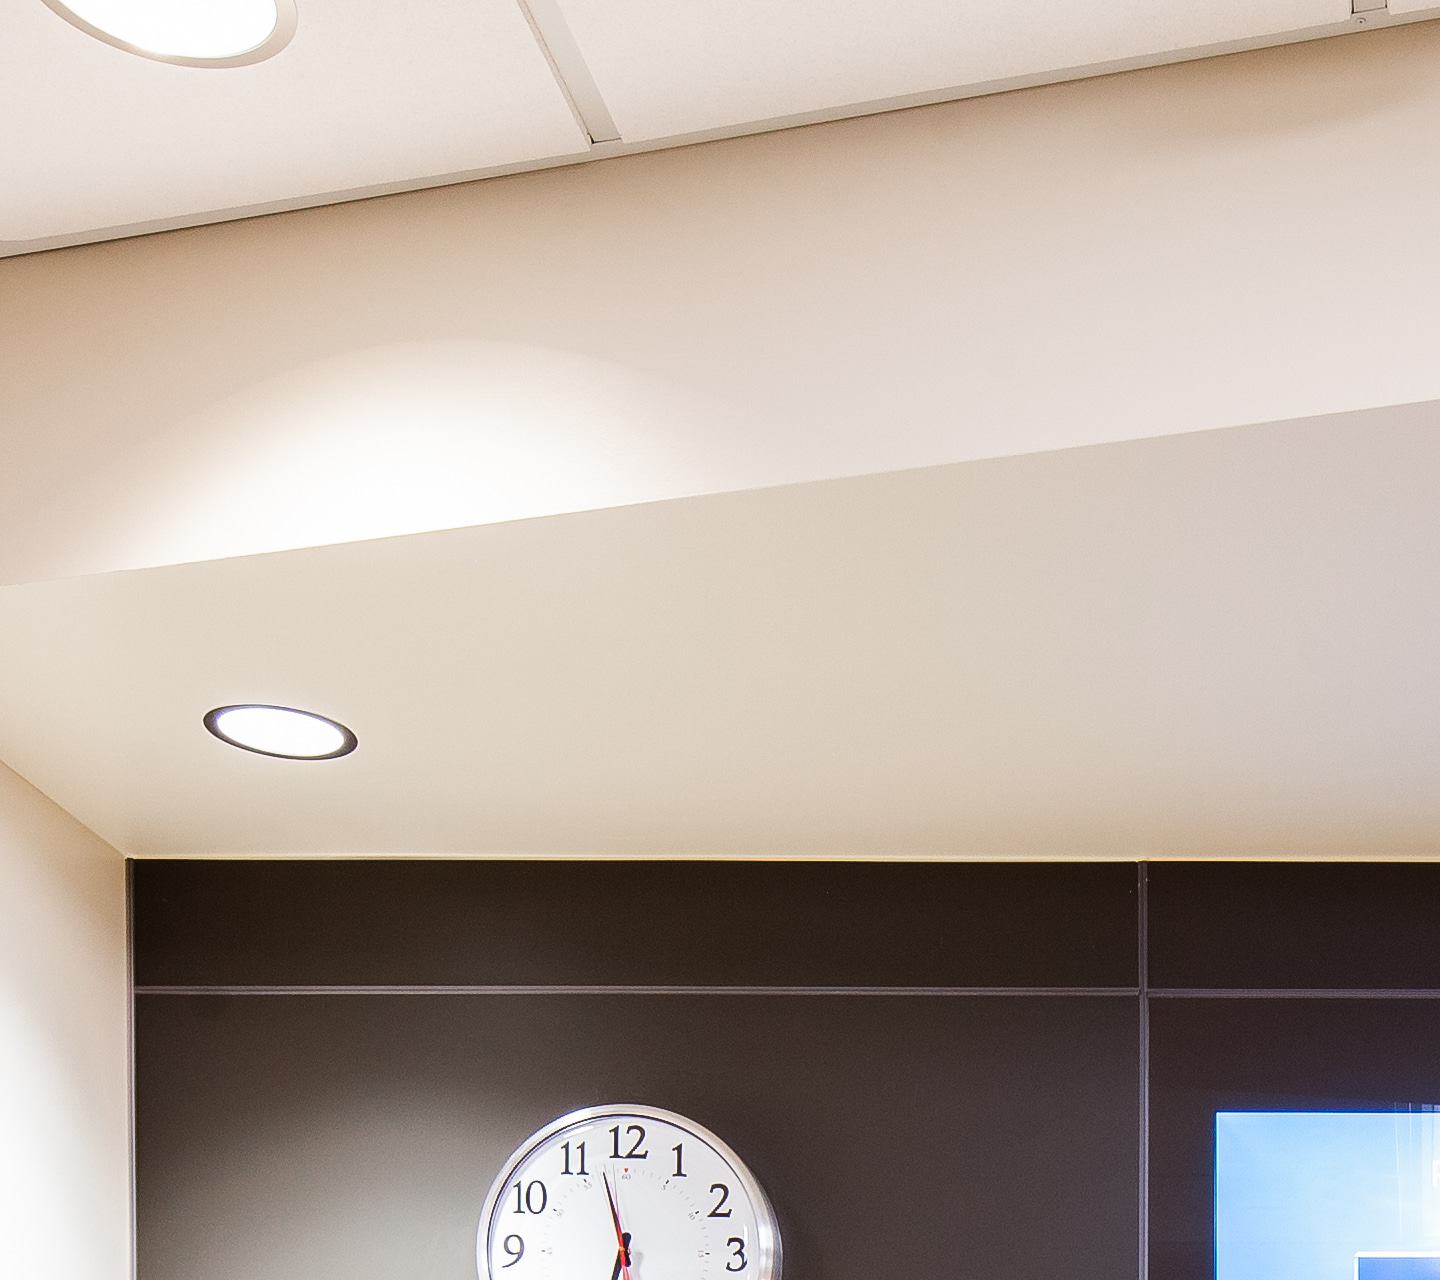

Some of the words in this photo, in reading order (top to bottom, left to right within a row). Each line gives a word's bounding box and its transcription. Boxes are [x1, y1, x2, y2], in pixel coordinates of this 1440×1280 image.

[560, 1140, 590, 1176] 11
[608, 1124, 649, 1160] 12
[671, 1142, 688, 1178] 1
[512, 1179, 548, 1215] 10
[706, 1183, 733, 1218] 2
[501, 1234, 525, 1269] 9
[725, 1236, 748, 1273] 3
